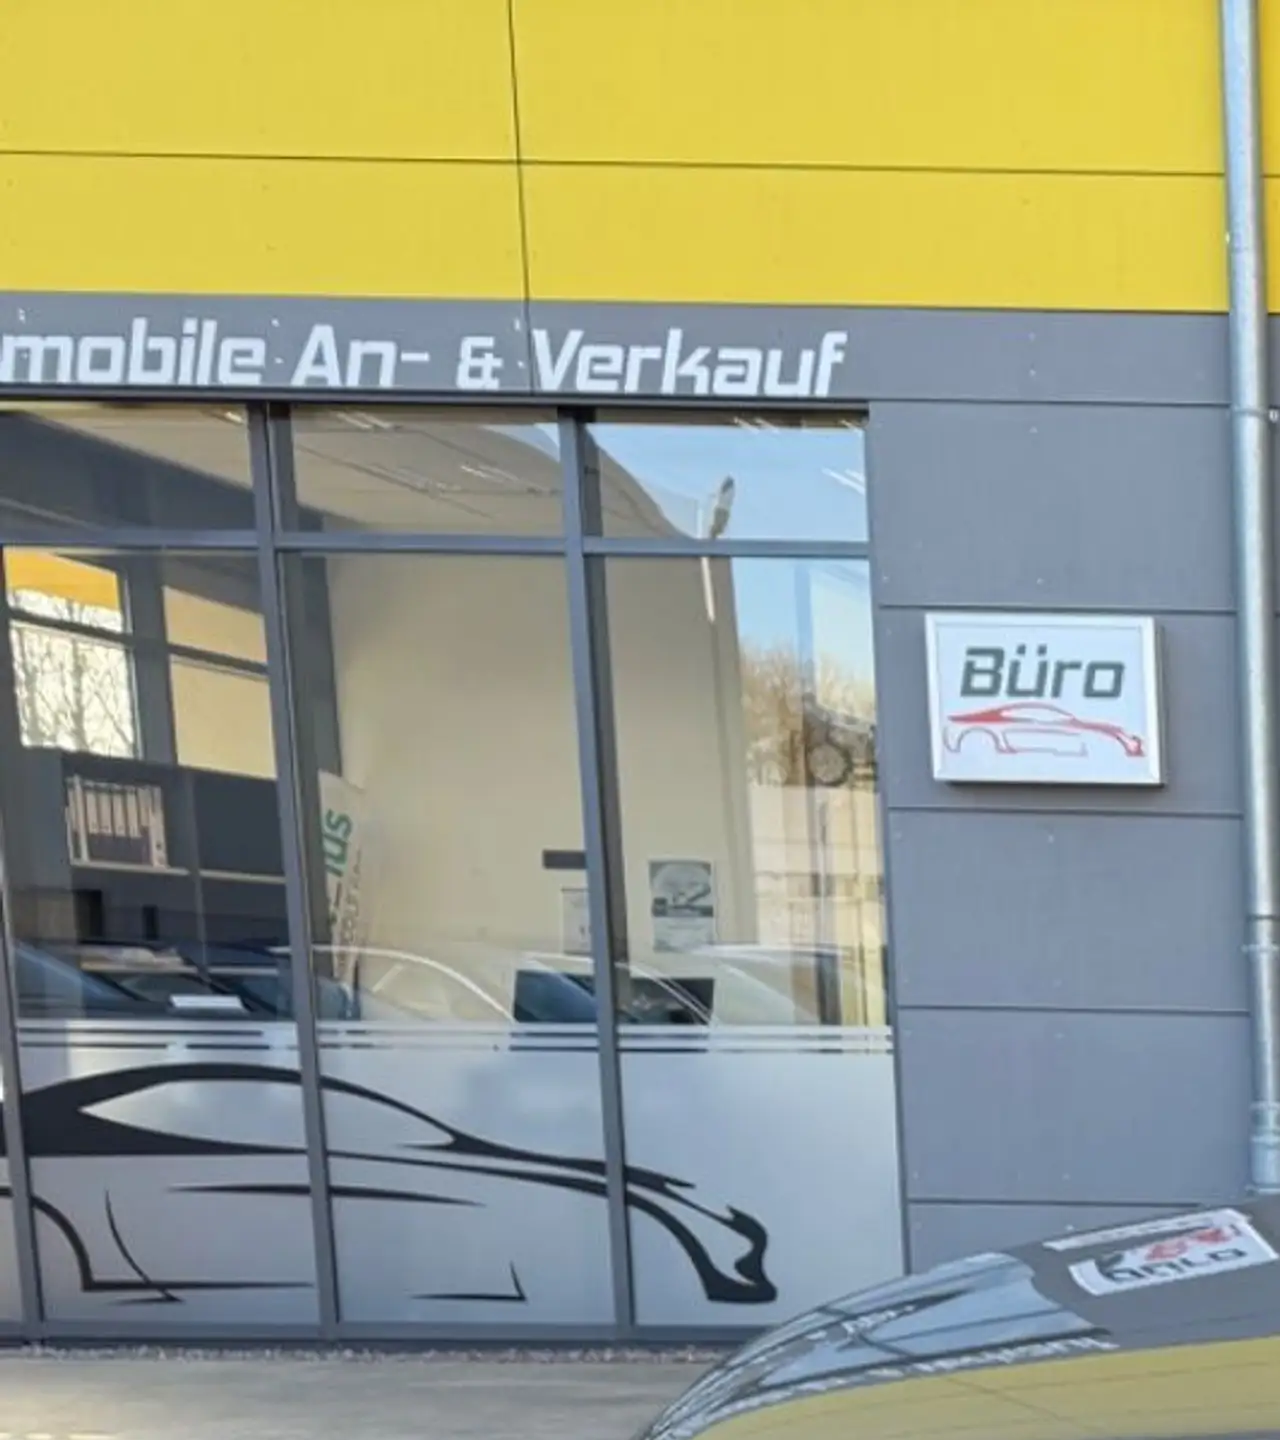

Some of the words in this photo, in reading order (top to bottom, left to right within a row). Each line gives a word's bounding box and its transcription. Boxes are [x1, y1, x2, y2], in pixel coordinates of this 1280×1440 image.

[290, 324, 430, 389] An-
[455, 335, 504, 391] &
[532, 328, 848, 397] Verkauf
[960, 644, 1125, 699] Büro
